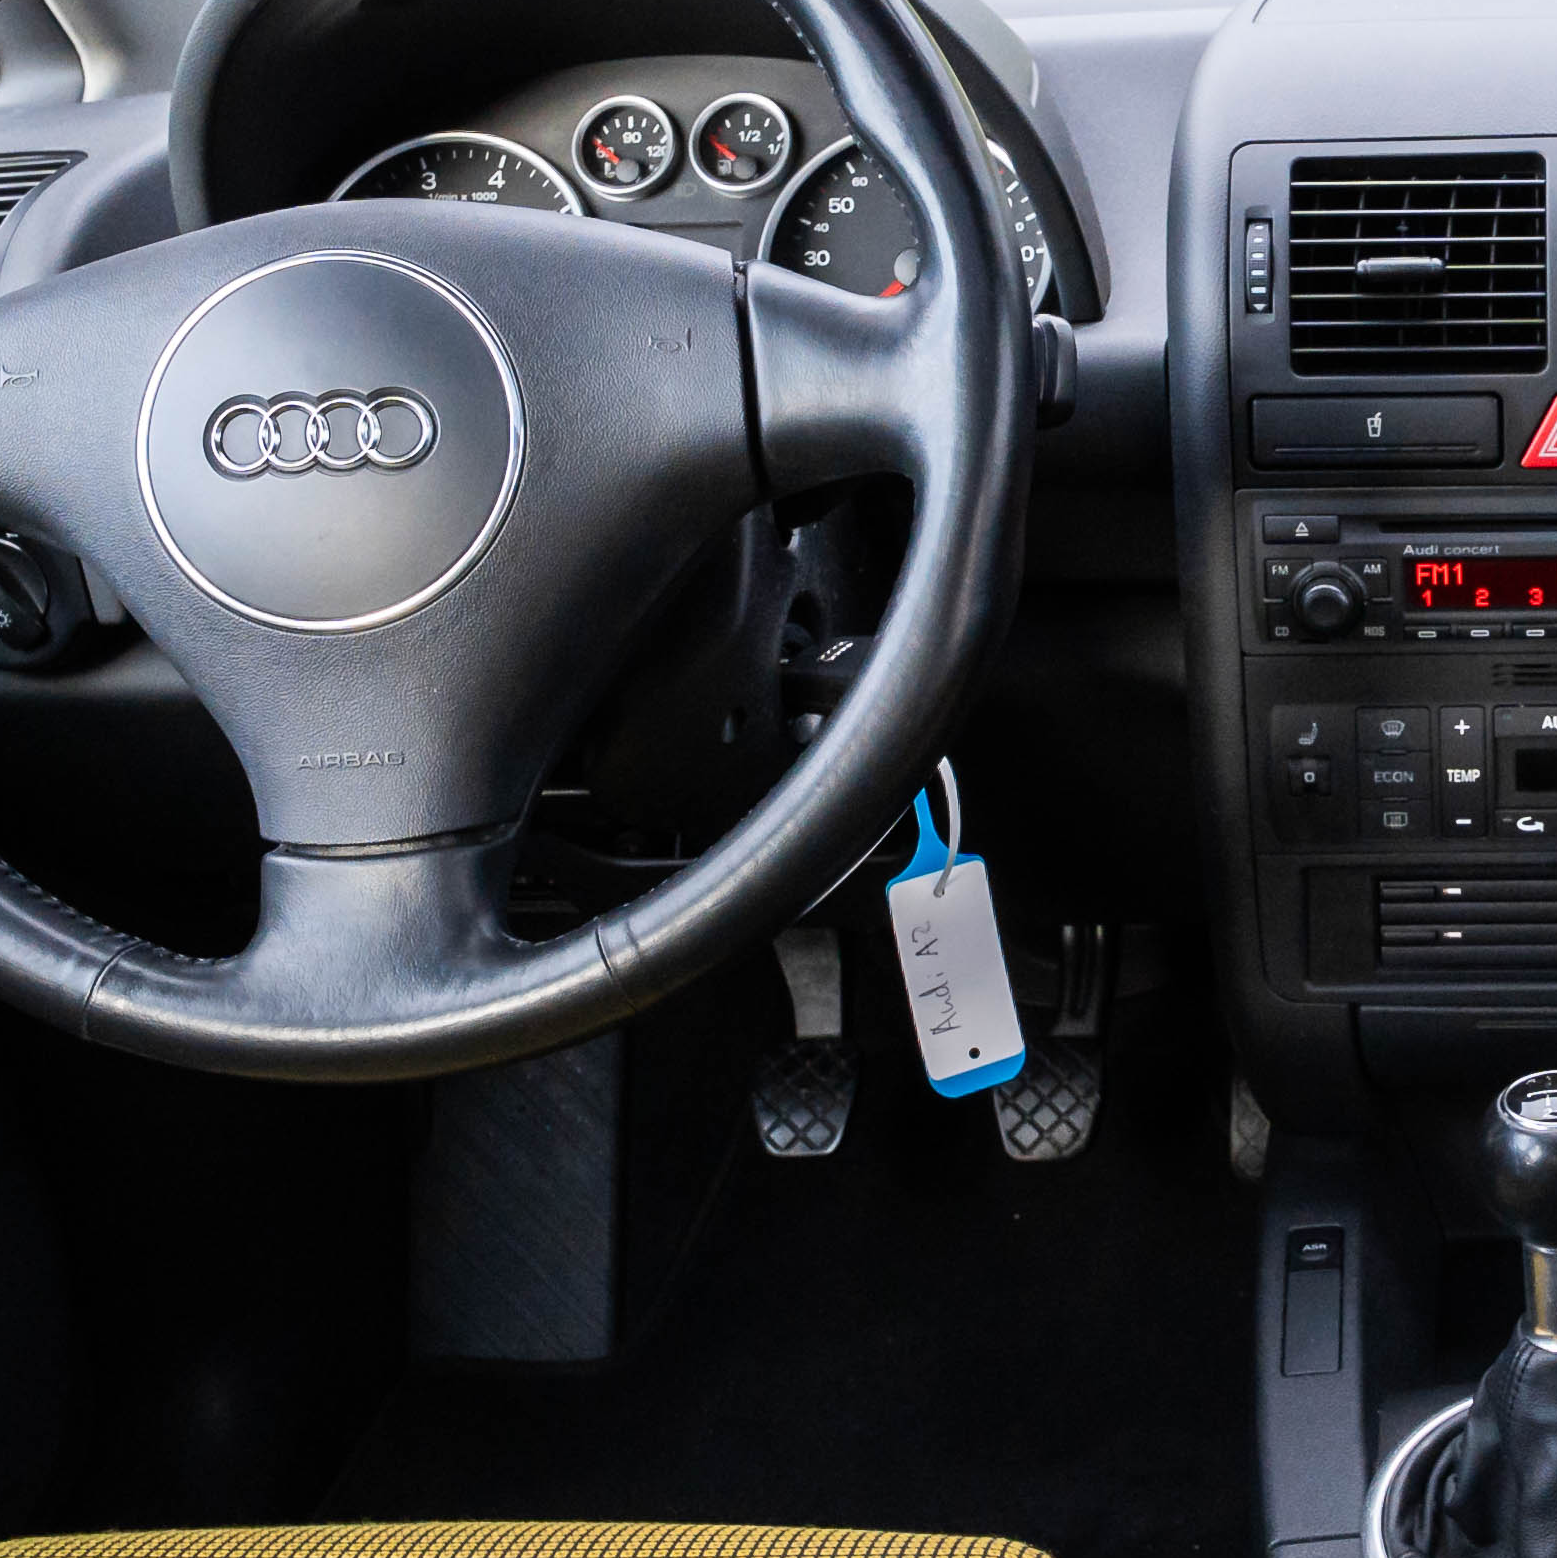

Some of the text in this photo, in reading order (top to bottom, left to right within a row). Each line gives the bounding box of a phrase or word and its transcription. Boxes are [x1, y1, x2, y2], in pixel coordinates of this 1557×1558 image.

[622, 131, 642, 143] 90
[739, 130, 761, 142] 1/2
[768, 143, 783, 155] 1/
[420, 171, 437, 190] 3
[487, 169, 505, 189] 4
[851, 176, 868, 187] 60
[471, 191, 498, 202] 1000
[828, 197, 855, 214] 50
[813, 222, 830, 233] 40
[803, 250, 831, 266] 30
[1403, 544, 1500, 556] Audi concert
[1271, 564, 1289, 576] FM
[1363, 562, 1382, 575] AM
[1415, 562, 1464, 586] FM1
[1421, 588, 1433, 607] 1
[1474, 588, 1490, 607] 2
[1527, 586, 1544, 607] 3
[1275, 626, 1290, 637] CD
[298, 749, 405, 770] AIRBAG
[1373, 769, 1415, 784] ECON
[1446, 768, 1481, 784] TEMP
[918, 971, 961, 1036] Audi
